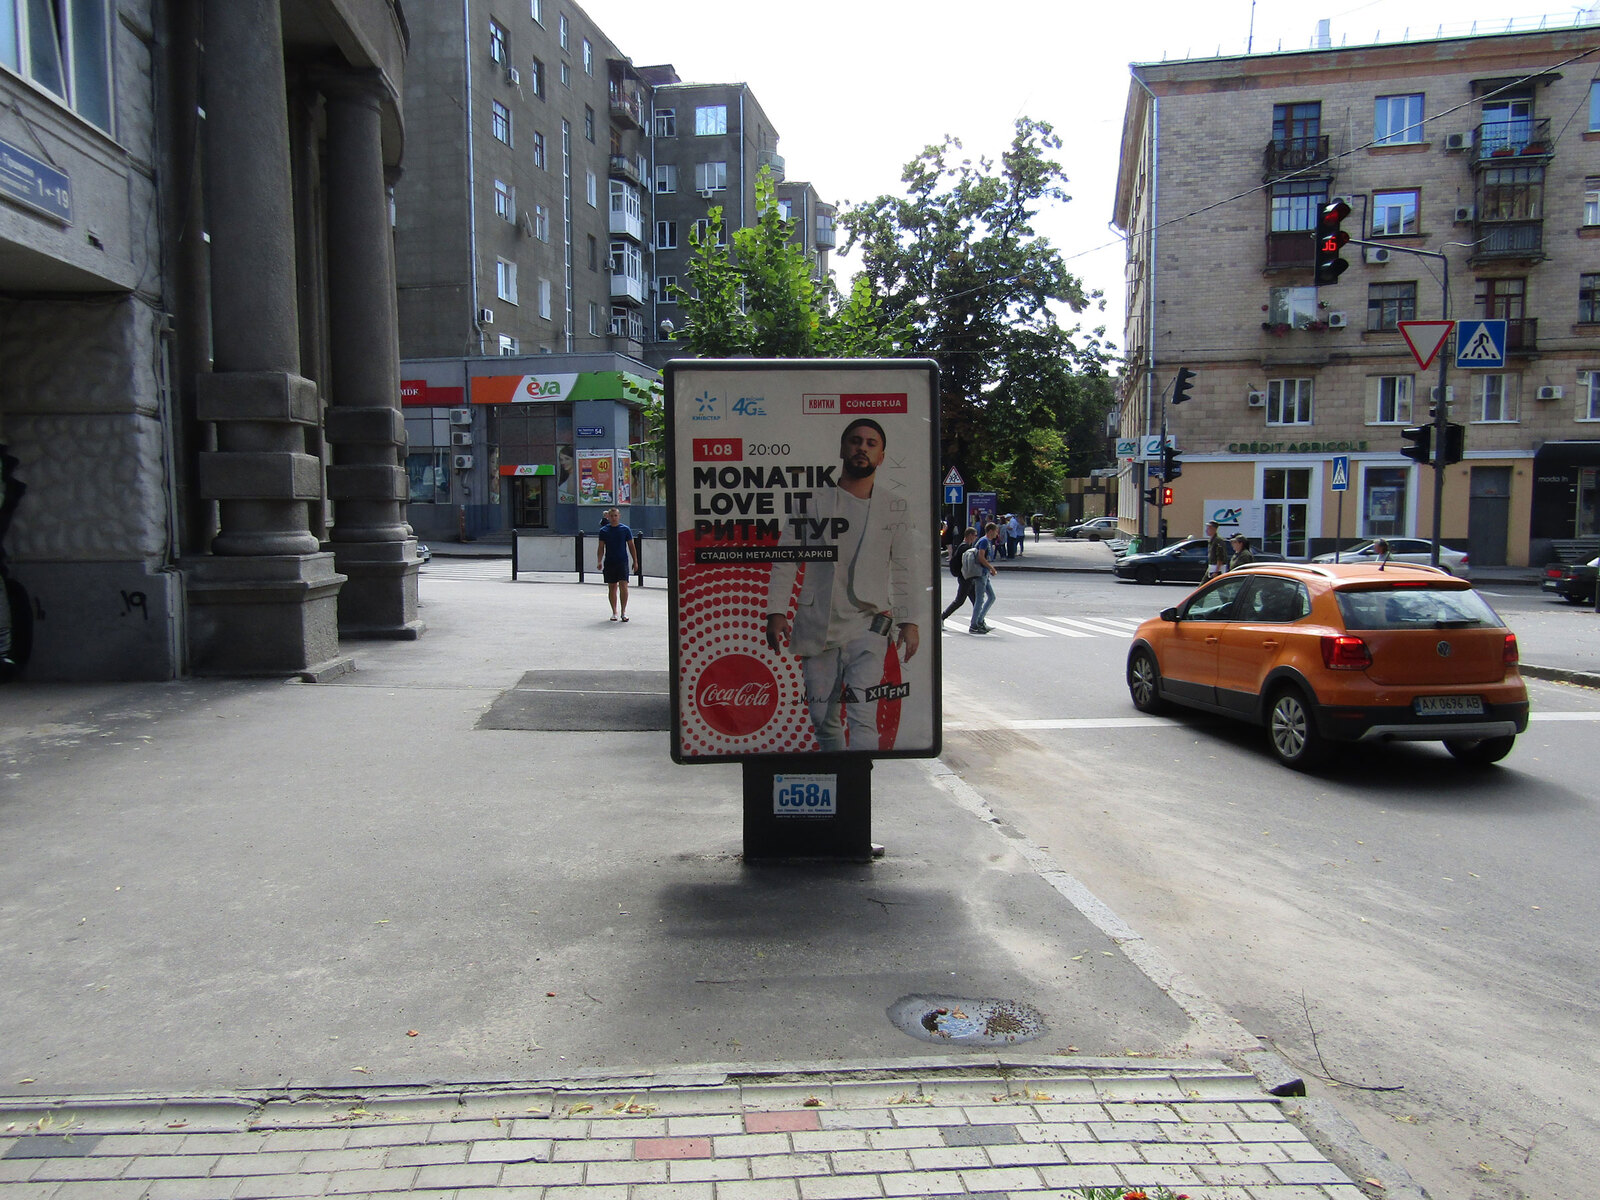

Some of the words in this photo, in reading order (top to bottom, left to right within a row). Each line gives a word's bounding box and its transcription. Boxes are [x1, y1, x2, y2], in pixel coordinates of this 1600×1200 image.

[808, 399, 835, 409] КВИТКИ
[845, 399, 902, 408] CONCERT.UA
[702, 444, 733, 456] 1.08
[748, 443, 791, 456] 20:00
[1287, 440, 1368, 453] AGRICOLE
[599, 460, 608, 471] 40
[693, 465, 838, 489] MONATIK
[694, 492, 775, 515] LOVE
[784, 491, 813, 514] IT
[694, 518, 780, 541] РИТМ
[789, 517, 850, 540] ТУР
[700, 551, 743, 560] СТАДІОН
[746, 551, 796, 559] МЕТАЛІСТ,
[798, 550, 834, 559] ХАРКІВ
[700, 682, 775, 708] Coca-Cola
[889, 685, 907, 699] FM
